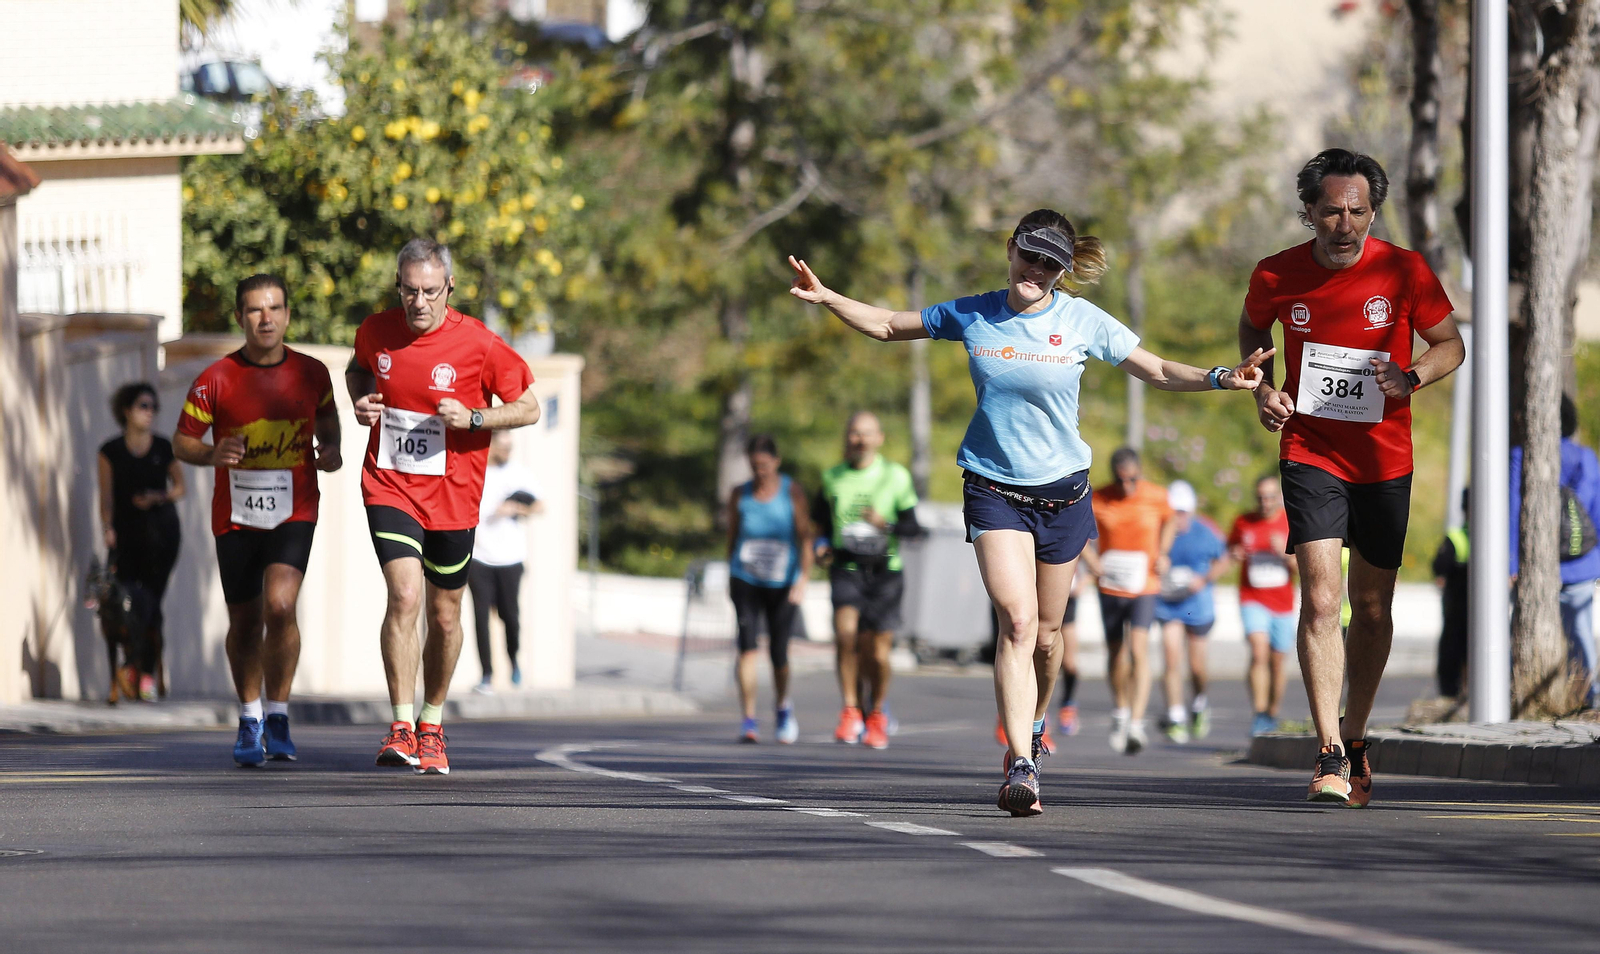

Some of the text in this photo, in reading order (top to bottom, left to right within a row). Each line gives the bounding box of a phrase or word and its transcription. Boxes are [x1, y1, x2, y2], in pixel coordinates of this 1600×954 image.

[1320, 377, 1364, 400] 384
[396, 436, 428, 455] 105
[245, 496, 276, 512] 443
